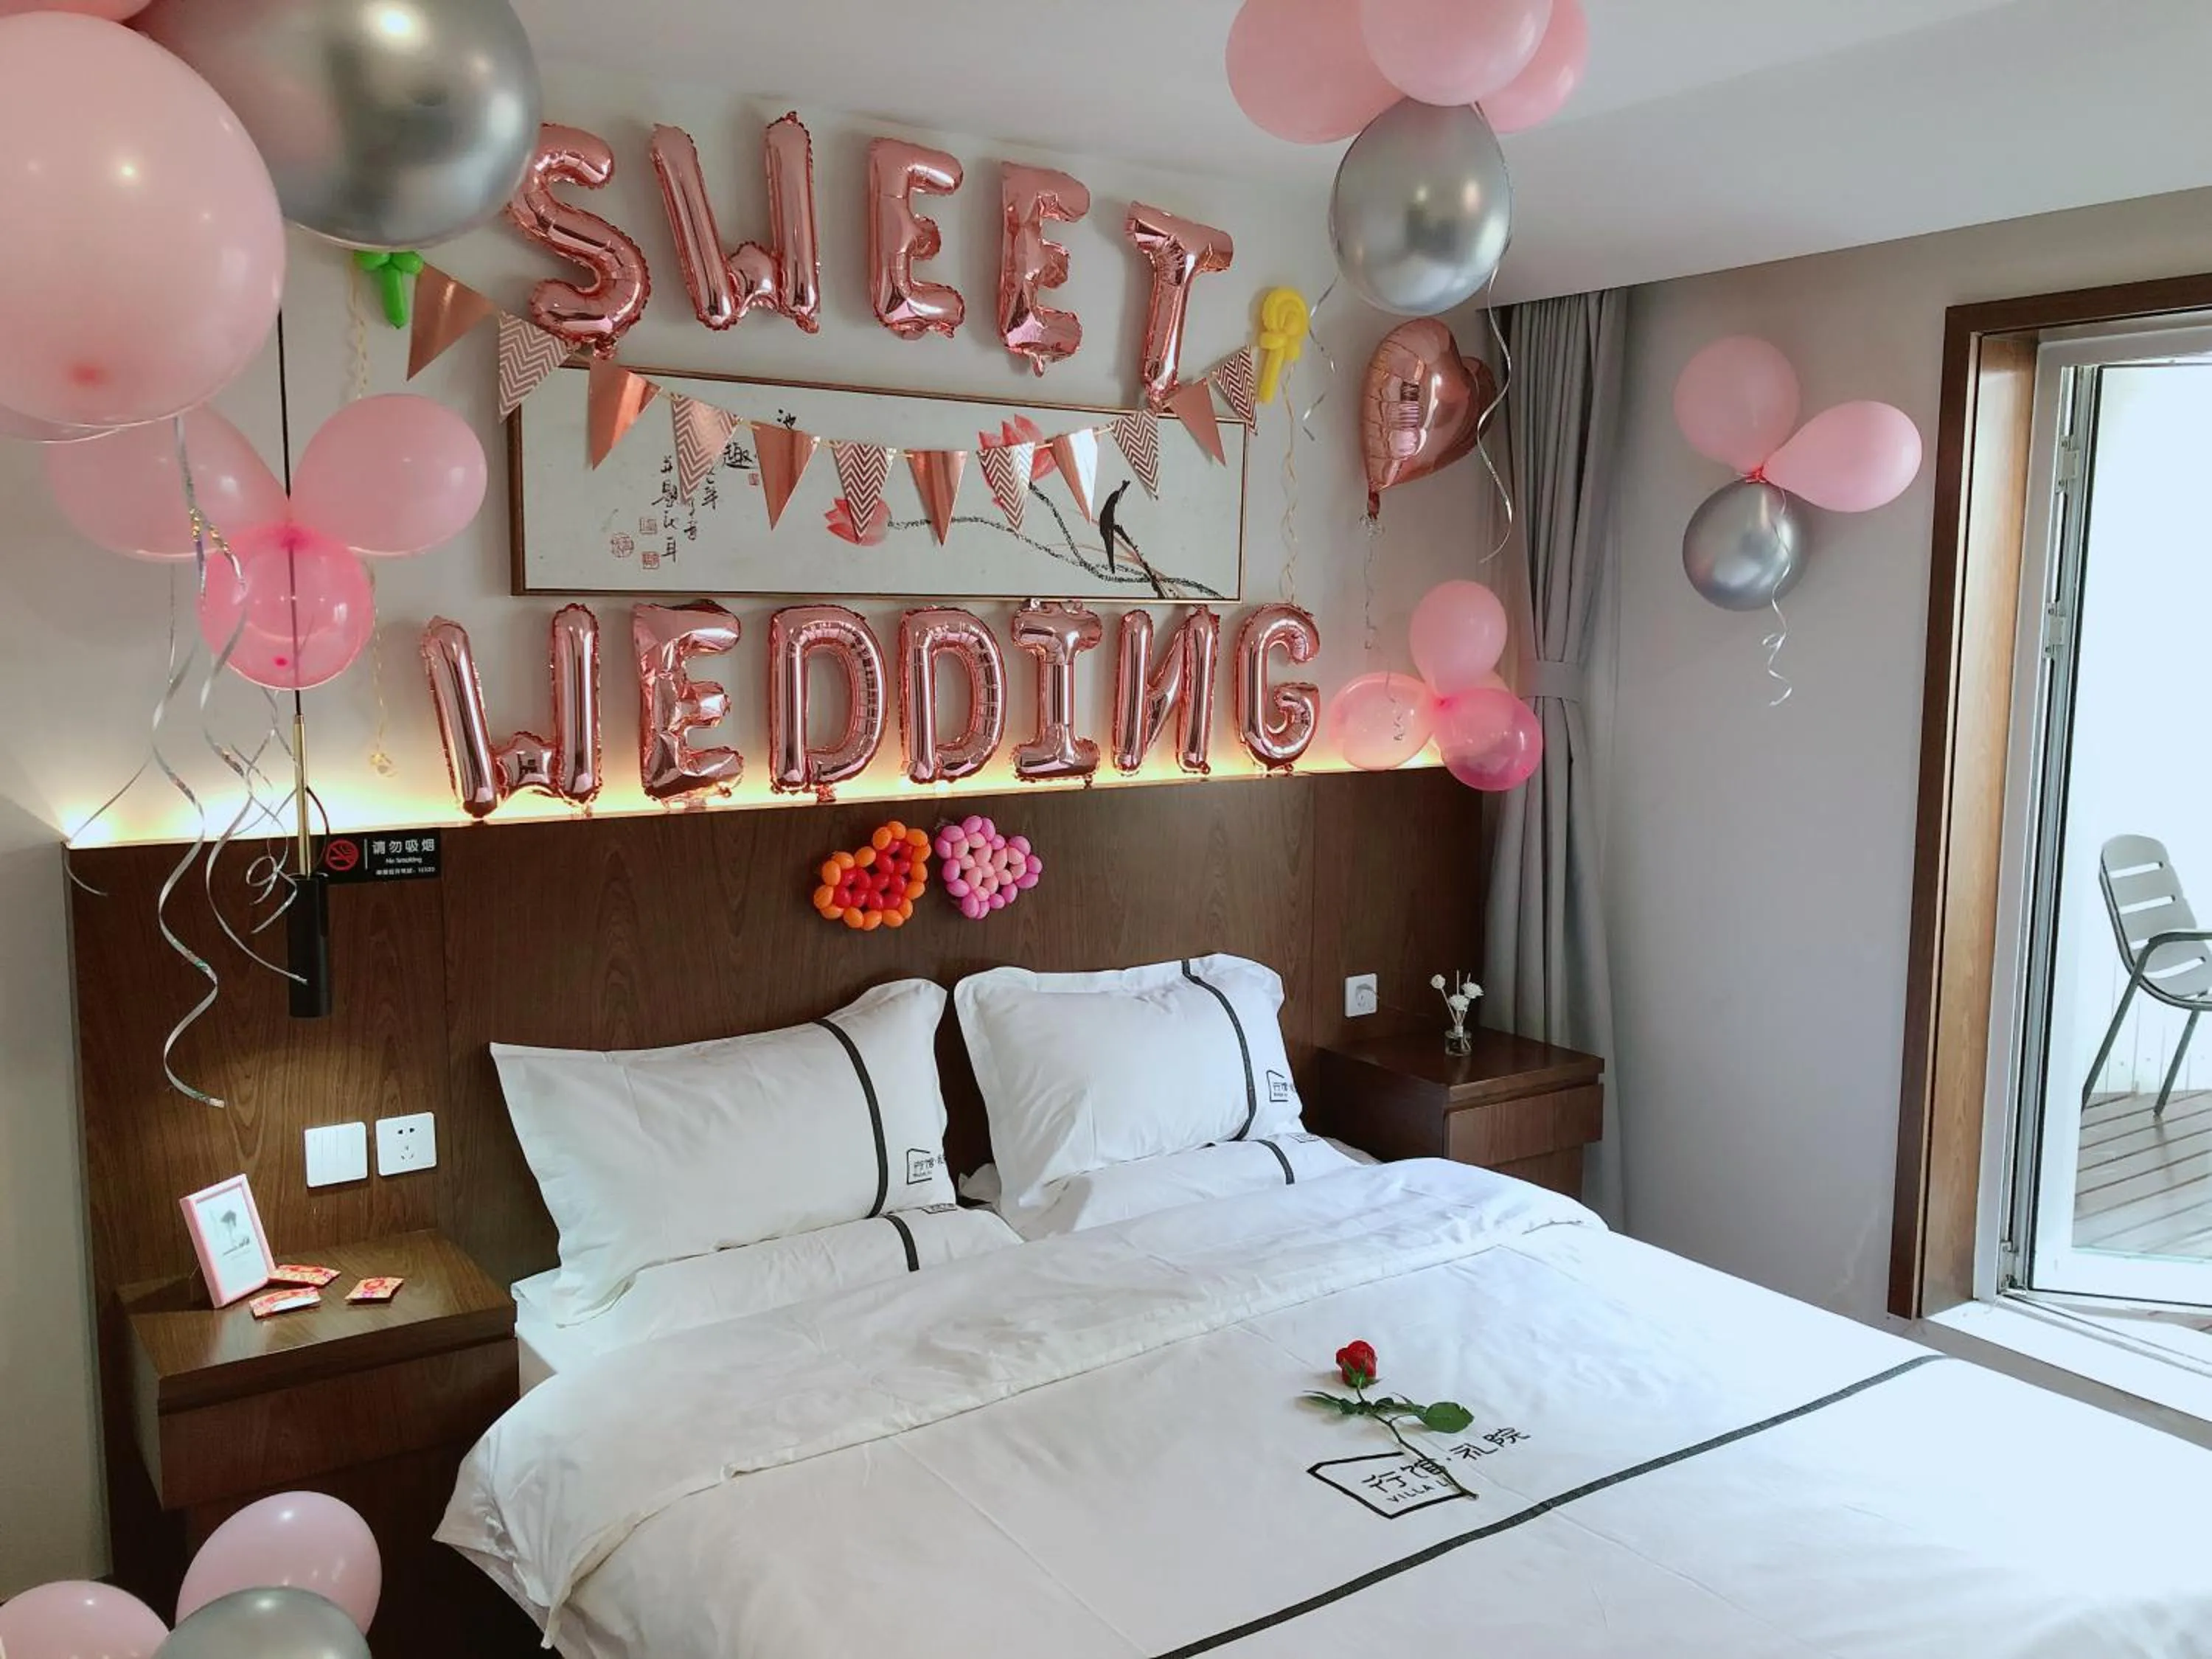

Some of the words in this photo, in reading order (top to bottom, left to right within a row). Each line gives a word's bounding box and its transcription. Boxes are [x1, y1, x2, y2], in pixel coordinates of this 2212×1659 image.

[506, 111, 1233, 404] SWEET
[420, 600, 1321, 819] WEDDING
[372, 838, 435, 855] 请勿吸烟
[1386, 1484, 1435, 1503] VILLA
